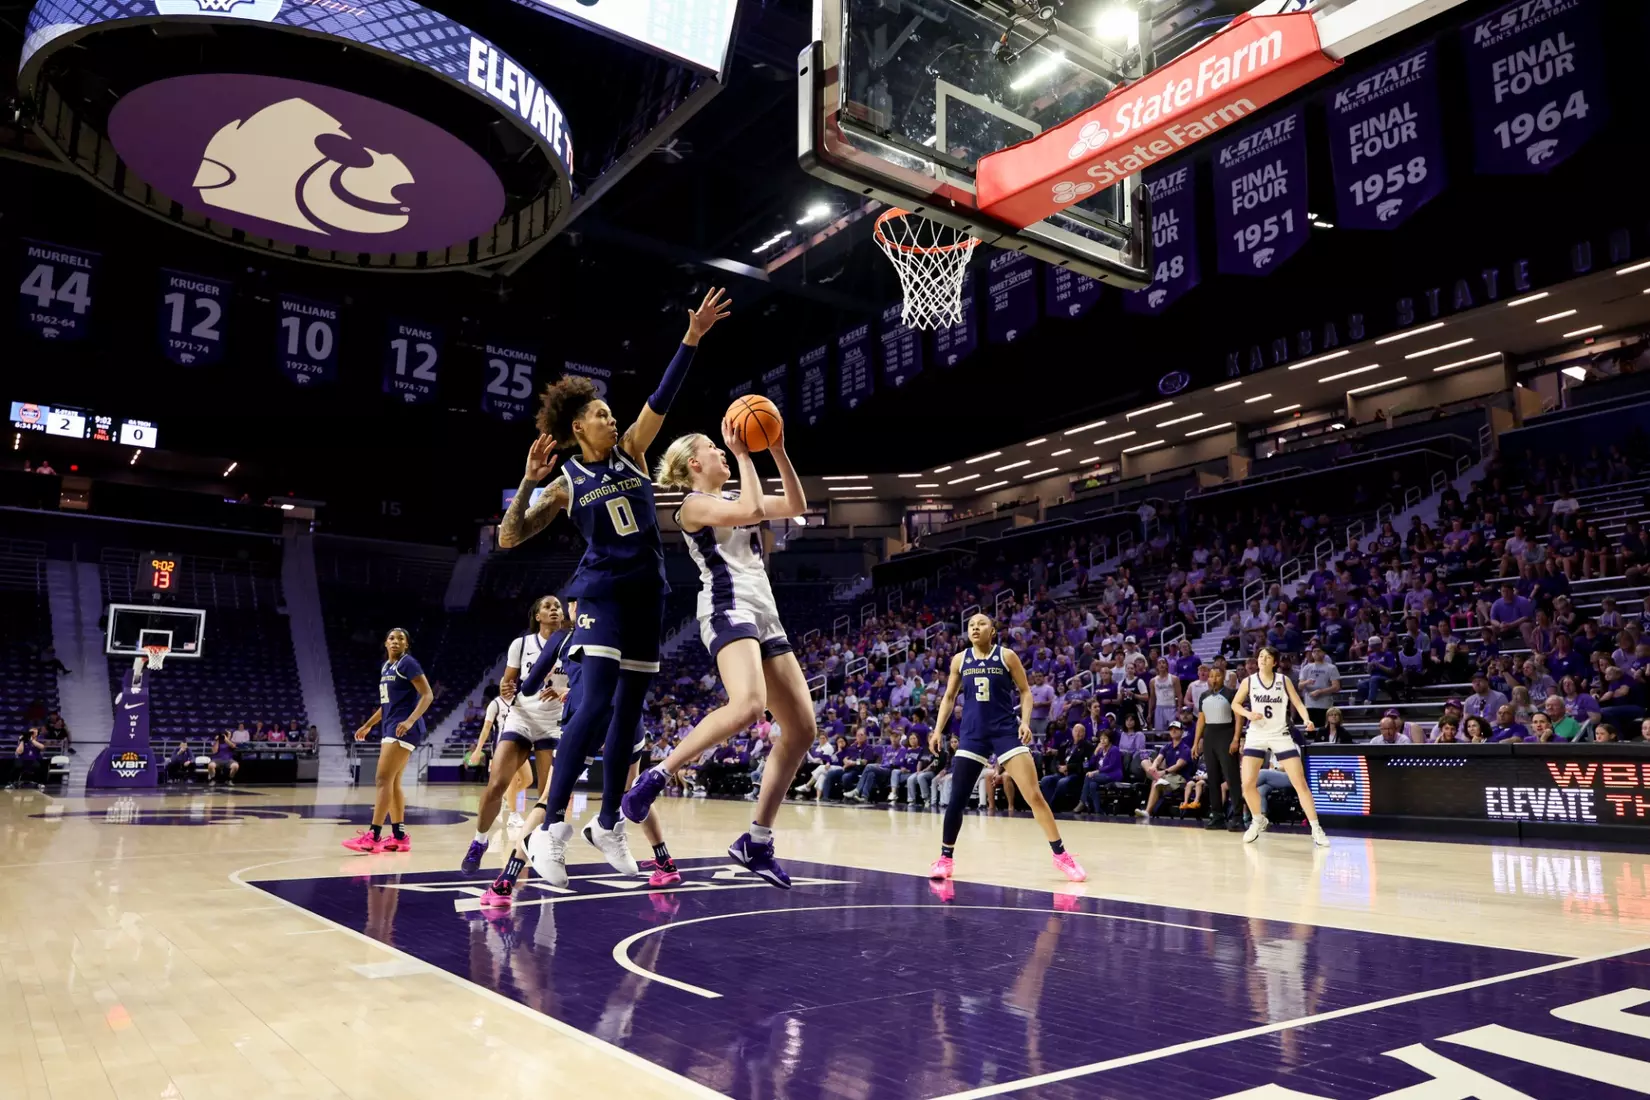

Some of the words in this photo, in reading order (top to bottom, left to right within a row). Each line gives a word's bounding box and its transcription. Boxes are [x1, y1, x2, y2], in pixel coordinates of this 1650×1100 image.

[1482, 30, 1512, 49] MEN'S
[1492, 31, 1576, 83] FINAL
[1334, 51, 1428, 110] K-STATE
[1341, 99, 1366, 114] MEN'S
[1367, 71, 1422, 103] BASKETBALL
[1494, 52, 1575, 104] FOUR
[468, 36, 563, 156] ELEVATE
[1349, 101, 1418, 145] FINAL
[1493, 89, 1589, 150] 1964
[1219, 114, 1297, 164] K-STATE
[1247, 132, 1292, 158] BASKETBALL
[1350, 120, 1418, 165] FOUR
[1148, 167, 1187, 196] TATE
[1231, 159, 1288, 198] FINAL
[1349, 156, 1428, 207] 1958
[1232, 177, 1288, 216] FOUR
[1233, 209, 1295, 253] 1951
[27, 246, 93, 269] MURRELL
[20, 263, 92, 315] 44
[169, 276, 220, 296] KRUGER
[1396, 257, 1532, 326] STATE
[29, 312, 76, 329] 1962-64
[164, 291, 222, 341] 12
[281, 299, 337, 320] WILLIAMS
[168, 338, 210, 354] 1971-74
[281, 315, 334, 361] 10
[399, 325, 432, 341] EVANS
[1225, 312, 1366, 378] KANSAS
[285, 359, 324, 375] 1972-76
[390, 338, 438, 382] 12
[485, 344, 537, 364] BLACKMAN
[486, 359, 533, 400] 25
[564, 361, 611, 378] RICHMOND
[14, 422, 31, 430] 6:34
[60, 418, 71, 431] 2
[95, 415, 112, 425] 9:02
[133, 429, 143, 440] 0
[579, 484, 619, 507] GEORGIA
[617, 476, 642, 492] TECH
[381, 500, 402, 516] 15
[605, 495, 640, 537] 0
[152, 559, 175, 571] 9:02
[152, 571, 170, 589] 13
[974, 676, 990, 702] 3
[1253, 694, 1282, 703] Wildcats
[1264, 705, 1273, 719] 6
[111, 760, 148, 769] WBIT
[1485, 787, 1597, 822] ELEVATE
